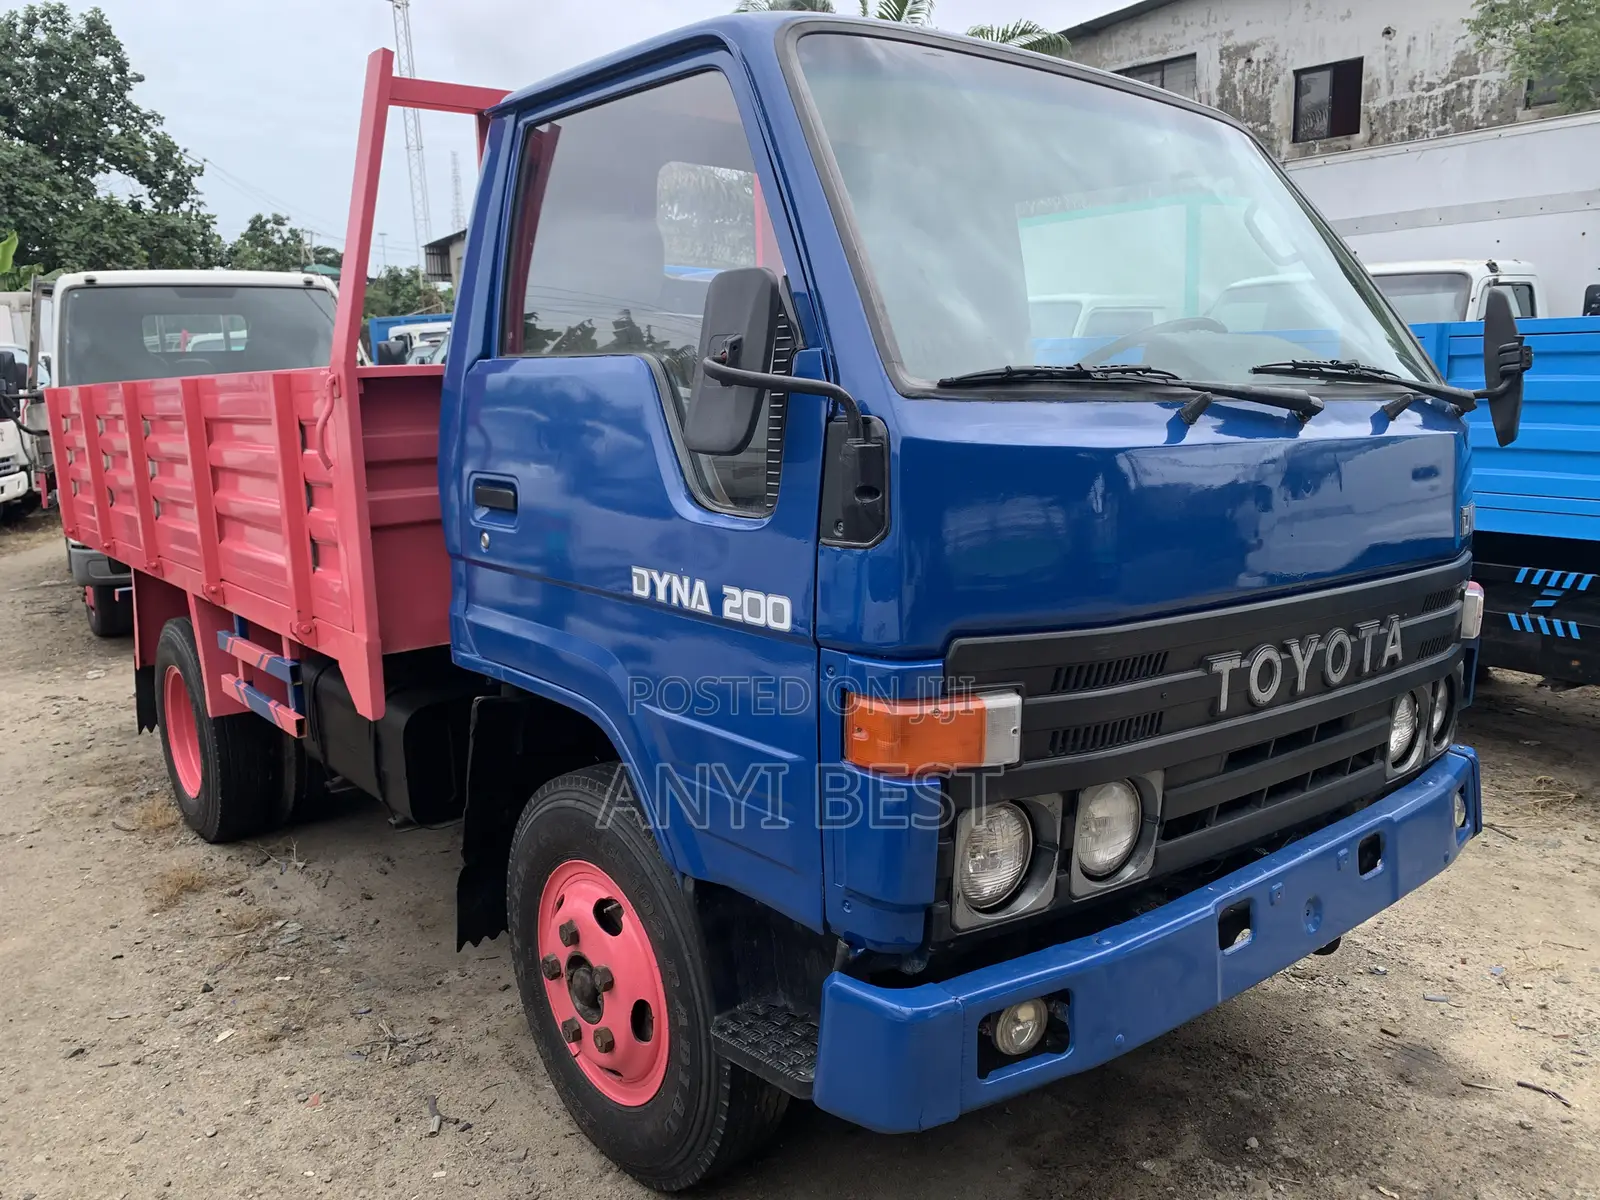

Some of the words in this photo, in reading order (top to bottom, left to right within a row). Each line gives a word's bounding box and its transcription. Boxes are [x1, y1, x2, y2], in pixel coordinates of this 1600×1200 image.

[631, 565, 713, 615] DYNA
[722, 584, 794, 632] 200
[1205, 614, 1403, 714] TOYOTA
